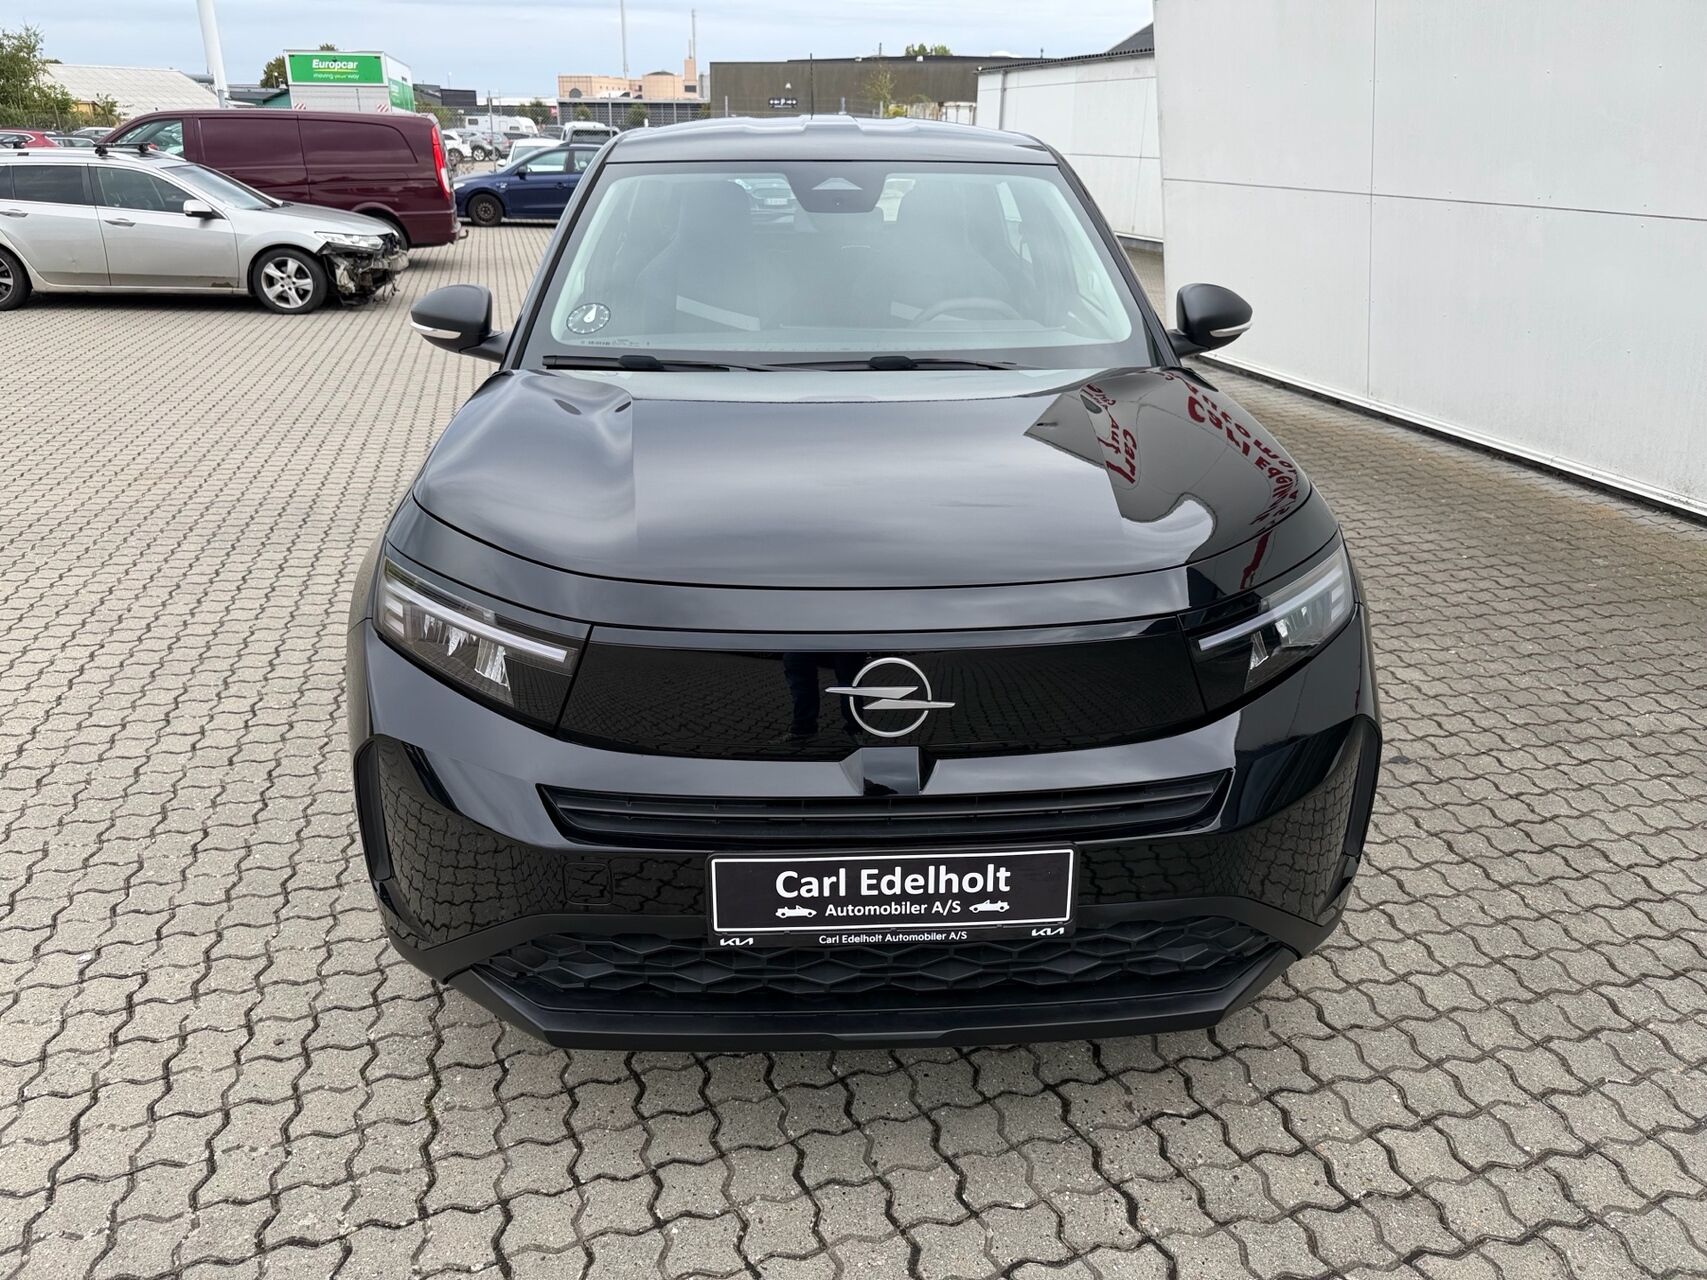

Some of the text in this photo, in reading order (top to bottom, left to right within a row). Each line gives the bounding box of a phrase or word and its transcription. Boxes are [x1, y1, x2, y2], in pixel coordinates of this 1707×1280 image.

[312, 58, 359, 71] Europcar
[775, 863, 1012, 899] Carl Edelholt
[824, 899, 962, 917] Automobiler A/S
[818, 930, 968, 945] Carl Edelholt Automobiler A/S
